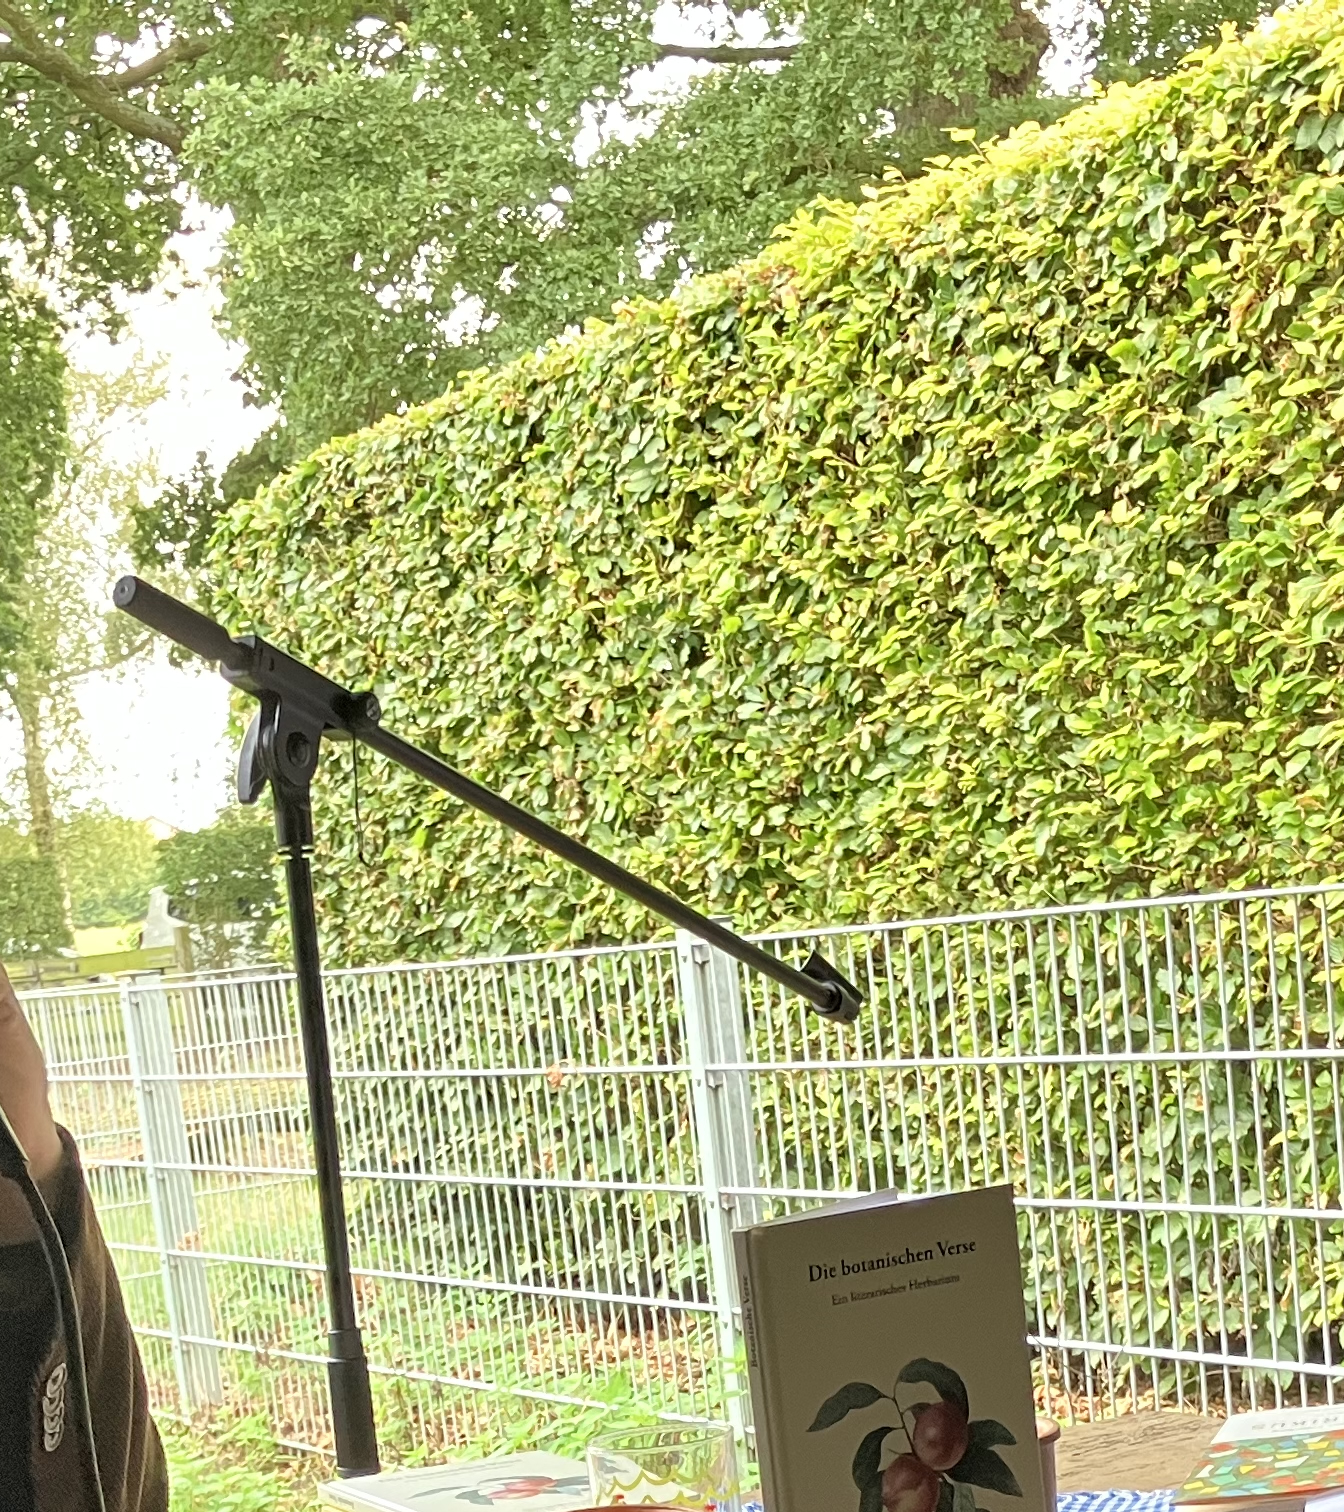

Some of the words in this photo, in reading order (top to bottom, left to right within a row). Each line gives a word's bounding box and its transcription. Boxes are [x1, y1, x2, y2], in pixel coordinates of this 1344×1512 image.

[808, 1263, 837, 1283] Die
[840, 1247, 934, 1277] botanischen
[936, 1240, 977, 1258] Verse
